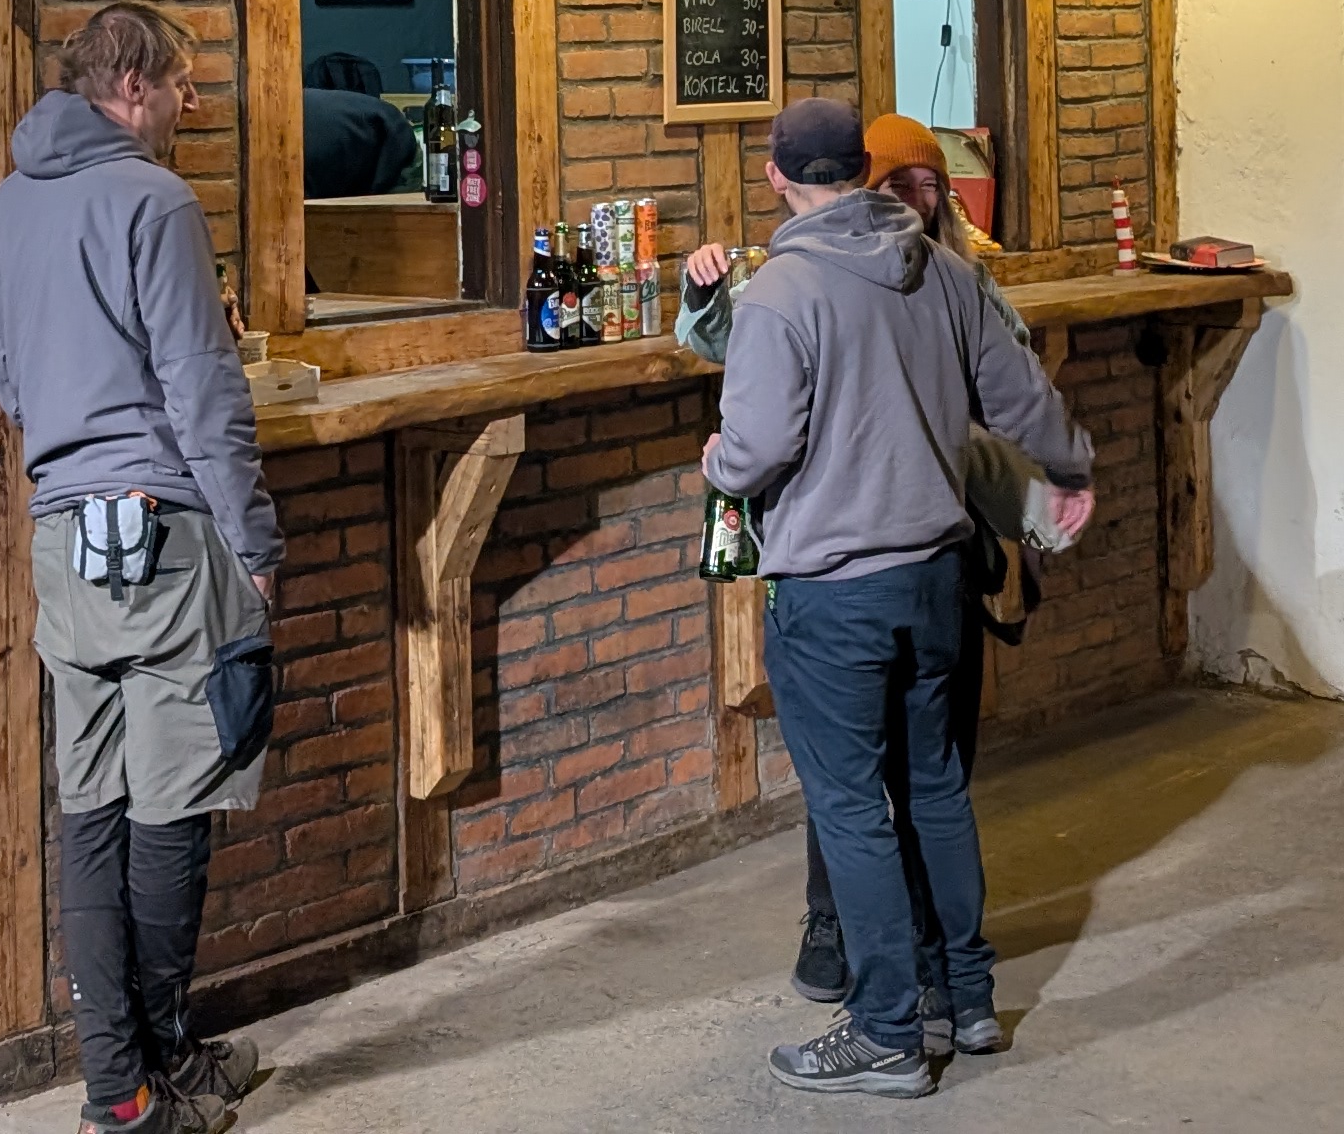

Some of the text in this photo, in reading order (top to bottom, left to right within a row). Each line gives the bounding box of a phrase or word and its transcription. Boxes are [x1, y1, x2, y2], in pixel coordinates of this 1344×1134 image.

[683, 16, 725, 34] BIRELL
[685, 49, 721, 66] COLA
[682, 74, 740, 98] KOKTEJL
[871, 1052, 906, 1069] SALOMON
